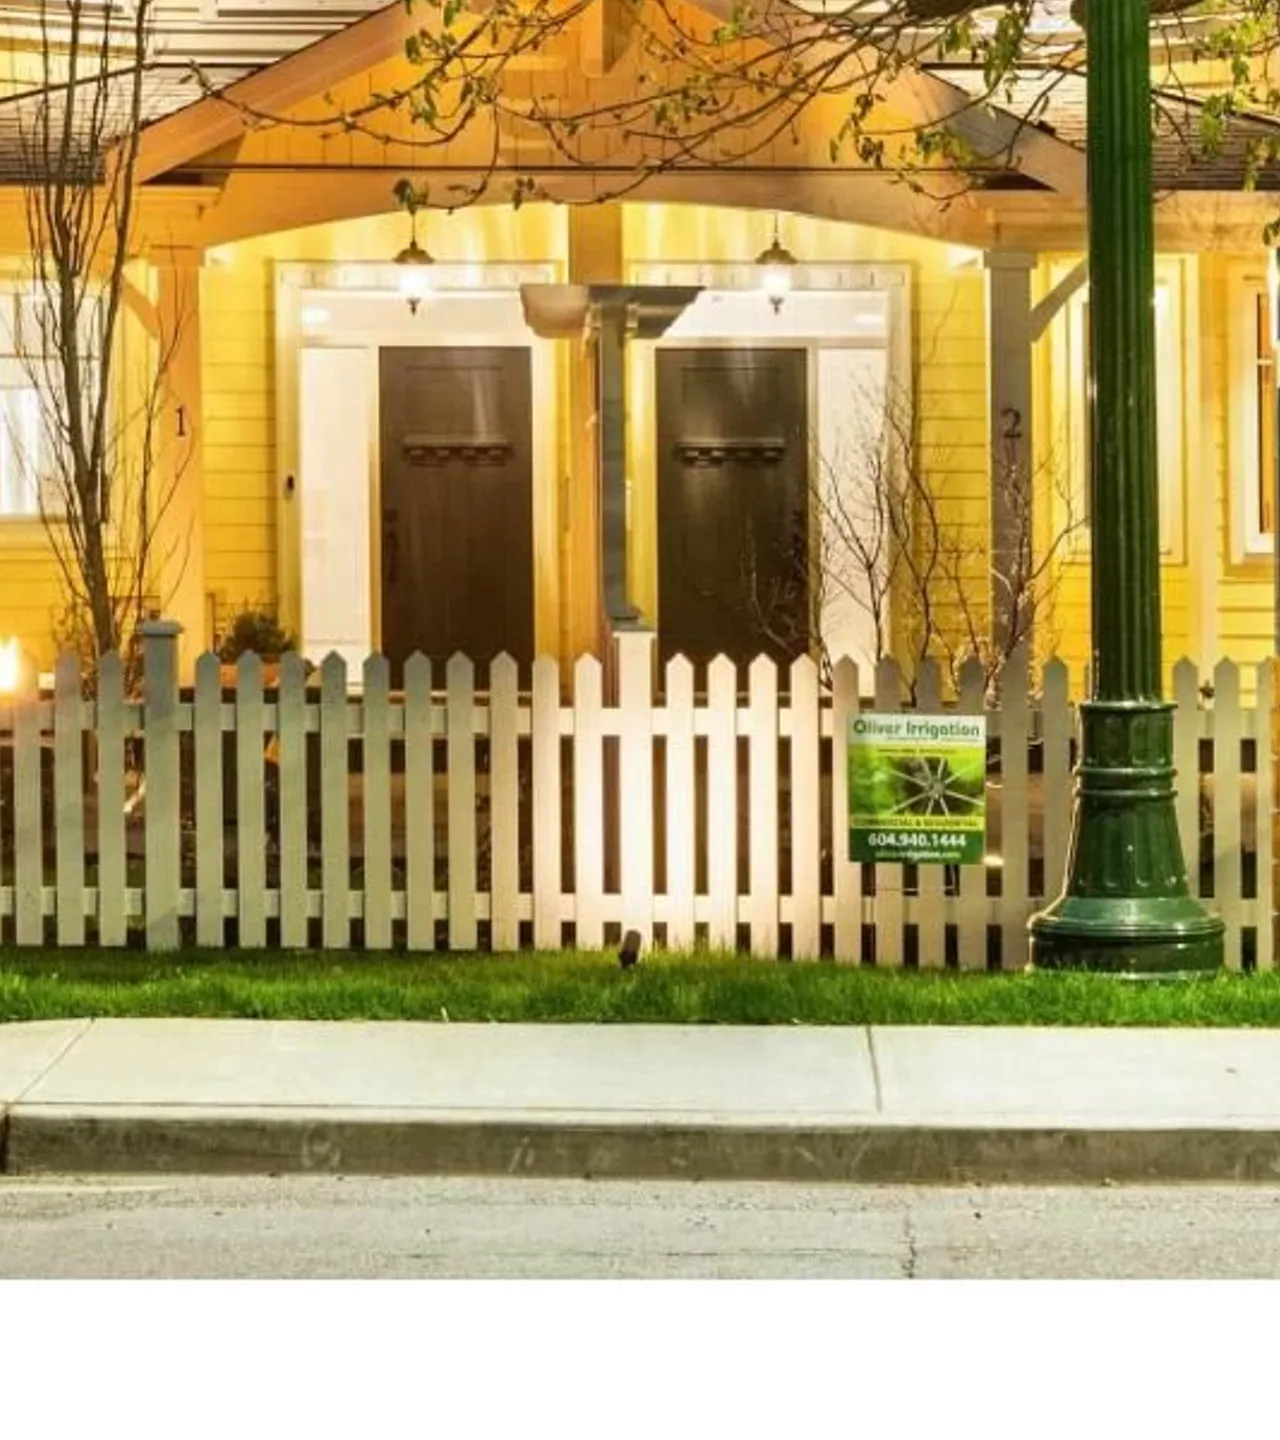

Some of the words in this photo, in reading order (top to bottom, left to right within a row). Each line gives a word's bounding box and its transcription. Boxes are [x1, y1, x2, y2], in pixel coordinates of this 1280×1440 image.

[175, 407, 186, 437] 1
[1001, 407, 1022, 438] 2
[853, 719, 900, 735] Oliver
[906, 720, 980, 739] Irrigation
